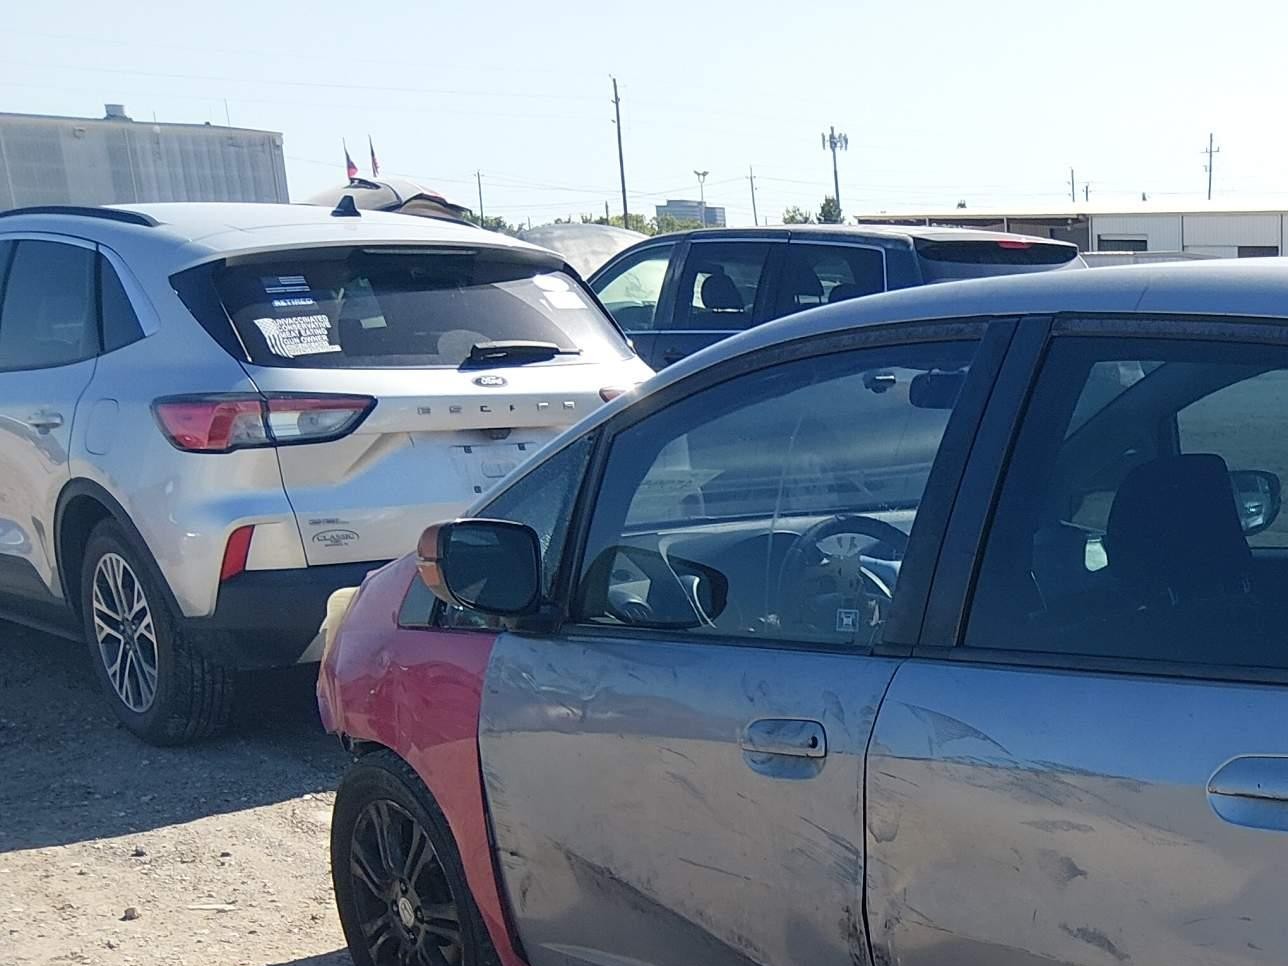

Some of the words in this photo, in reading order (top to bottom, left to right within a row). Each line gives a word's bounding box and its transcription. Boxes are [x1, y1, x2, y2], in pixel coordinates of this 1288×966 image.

[279, 330, 300, 338] MEAT
[283, 337, 300, 345] GUN
[301, 335, 329, 343] OWNER
